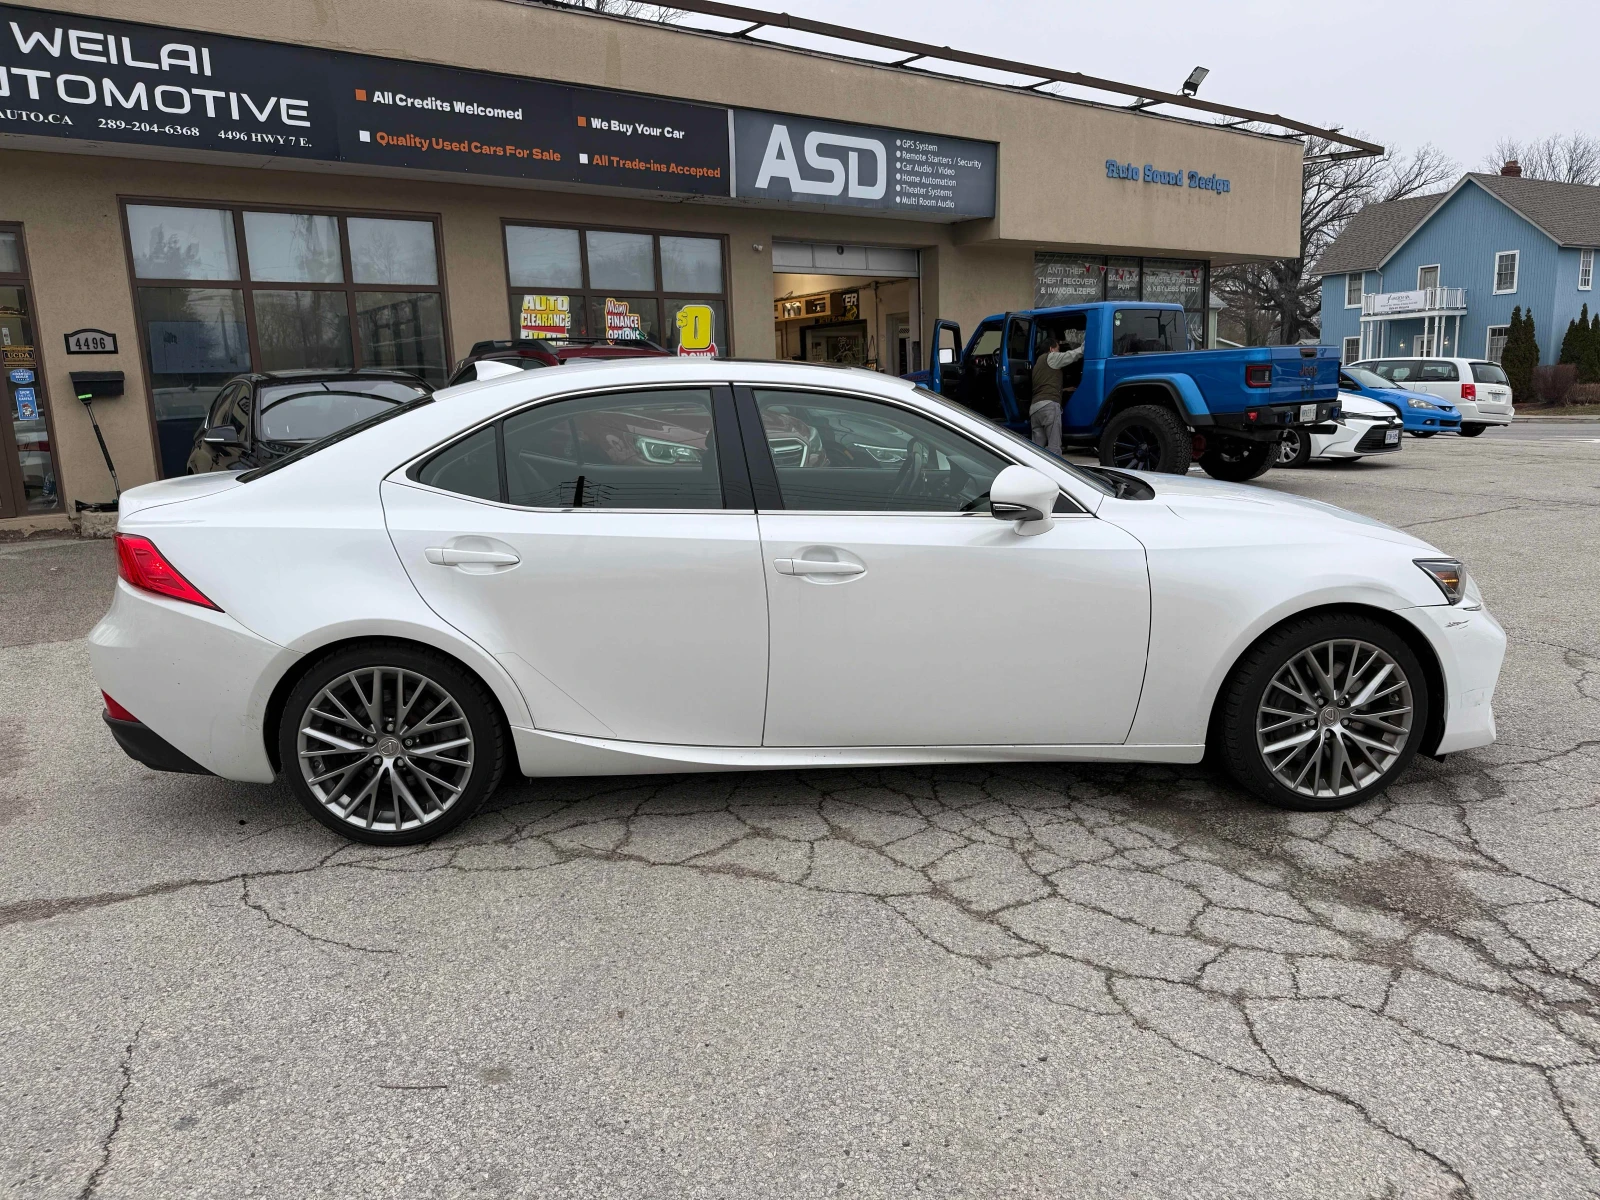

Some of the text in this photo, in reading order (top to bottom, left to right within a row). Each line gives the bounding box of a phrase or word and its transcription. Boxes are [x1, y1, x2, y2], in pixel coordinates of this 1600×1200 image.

[9, 21, 213, 77] WEILAI
[373, 91, 523, 120] All Credits Welcomed
[98, 118, 200, 138] 289-204-6368
[217, 130, 248, 143] 4496
[251, 133, 286, 147] HWY
[288, 136, 296, 147] 7
[300, 137, 313, 147] E.
[591, 117, 685, 139] We Buy Your Car
[376, 131, 561, 162] Quality Used Cars For Sale
[902, 139, 938, 152] GPS System
[592, 154, 721, 179] All Trade-ins Accepted
[755, 123, 887, 200] ASD
[902, 150, 927, 161] Remote
[927, 153, 952, 165] Starters
[957, 157, 982, 170] Security
[902, 162, 913, 171] Car
[914, 163, 932, 173] Audio
[938, 165, 956, 176] Video
[902, 173, 957, 187] Home Automation
[1105, 159, 1231, 195] Auto Sound Design
[902, 184, 953, 198] Theater Systems
[901, 196, 955, 208] Multi Room Audio
[1047, 266, 1087, 275] ANTI THEFT
[1038, 277, 1098, 286] THEFT RECOVERY
[1047, 287, 1096, 295] IMMOBILIZERS
[523, 296, 569, 311] AUTO
[607, 300, 627, 315] Many
[521, 313, 571, 328] CLEARANCE
[608, 315, 638, 328] FINANCE
[608, 329, 640, 340] OPTIONS
[75, 337, 106, 350] 4496
